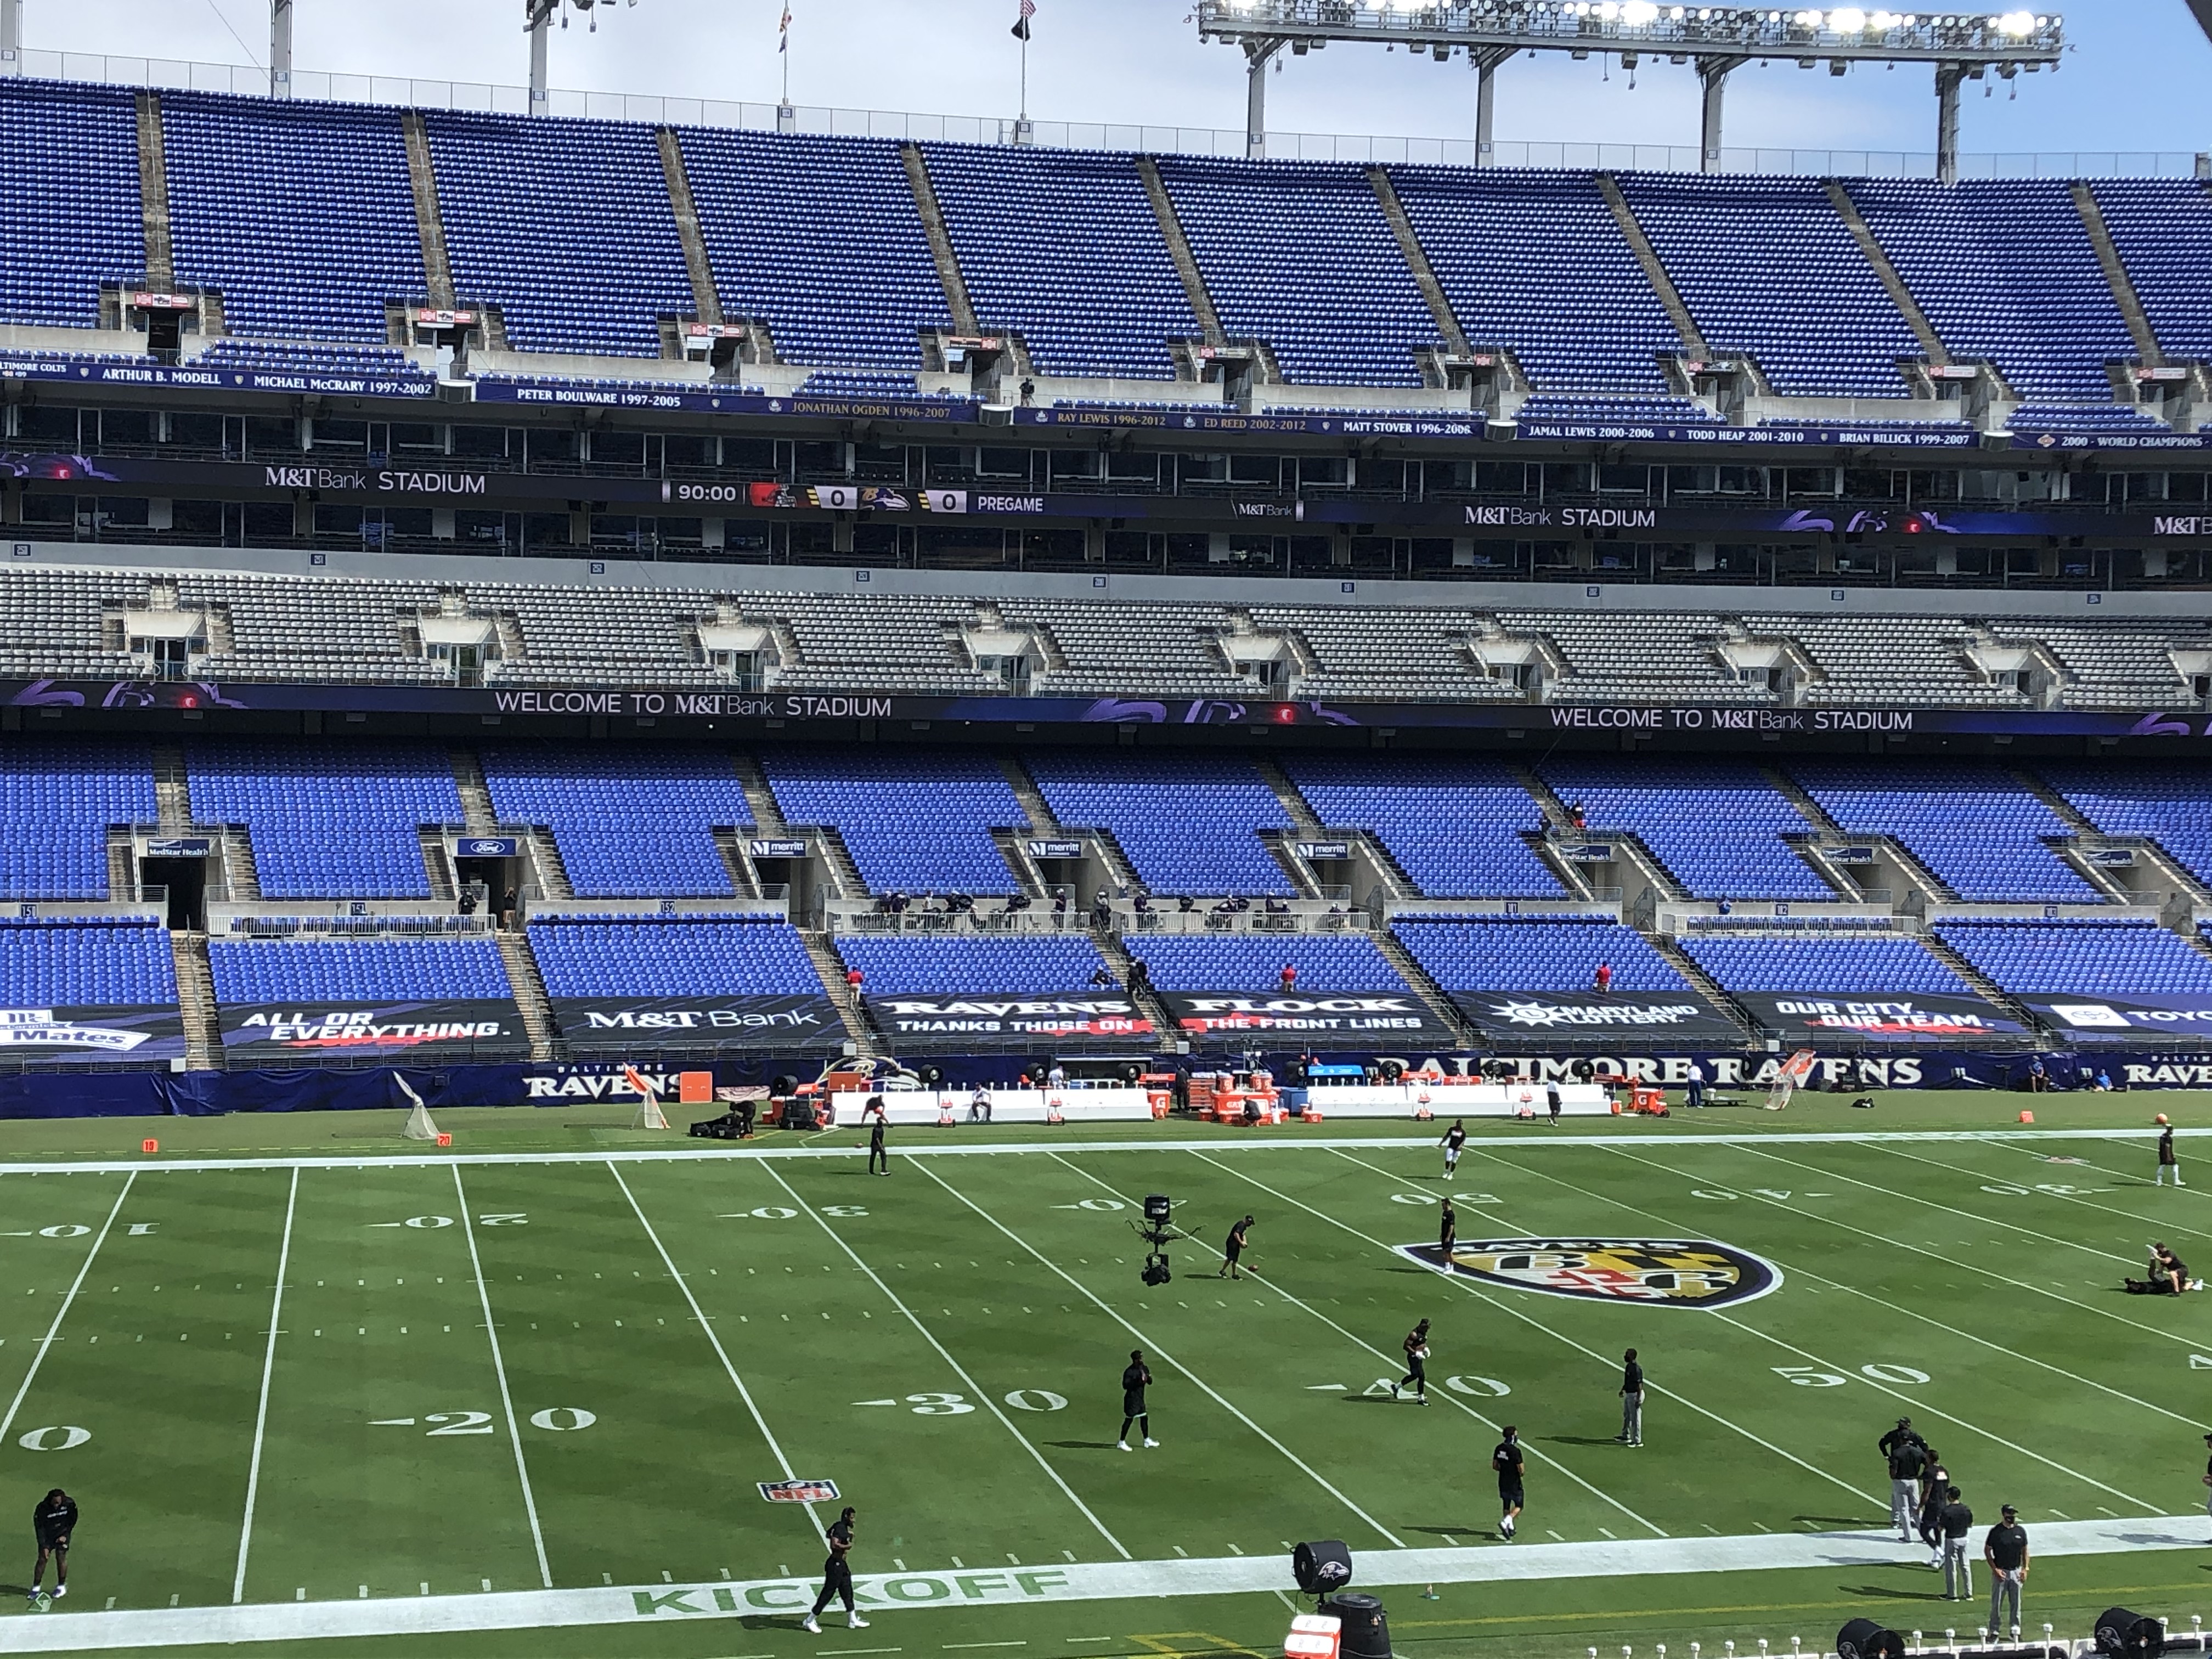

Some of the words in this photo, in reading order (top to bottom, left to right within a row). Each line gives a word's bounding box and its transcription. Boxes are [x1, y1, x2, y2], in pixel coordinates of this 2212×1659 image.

[40, 364, 66, 373] COLTS
[103, 369, 154, 381] ARTHUR
[156, 370, 167, 381] B.
[172, 371, 221, 384] MODELL
[254, 375, 307, 389] MICHAEL
[310, 379, 365, 391] McCRARY
[370, 381, 432, 396] 1997-2002
[517, 388, 552, 400] PETER
[556, 391, 617, 404] BOULWARE
[620, 394, 681, 407] 1997-2005
[792, 402, 849, 415] JONATHAN
[852, 404, 890, 416] OGDEN
[893, 406, 950, 418] 1996-2007
[1058, 413, 1077, 423] RAY
[1079, 413, 1110, 424] LEWIS
[1113, 415, 1166, 426] 1996-2012
[1204, 418, 1218, 428] ED
[1221, 419, 1247, 429] REED
[1250, 420, 1306, 430] 2002-2012
[1344, 421, 1372, 433] MATT
[1373, 422, 1413, 434] STOVER
[1528, 426, 1562, 437] JAMAL
[1565, 426, 1596, 437] LEWIS
[1598, 427, 1655, 438] 2000-2006
[1686, 429, 1716, 439] TODD
[1718, 430, 1745, 441] HEAP
[1747, 431, 1804, 442] 2001-2010
[1839, 433, 1871, 443] BRIAN
[1873, 433, 1912, 444] BILLICK
[1915, 434, 1970, 444] 1999-2007
[2061, 436, 2088, 447] 2000
[2097, 437, 2137, 447] WORLD
[2140, 437, 2203, 447] CHAMPIONS
[265, 466, 317, 488] M&T
[319, 468, 366, 490] Bank
[377, 471, 486, 494] STADIUM
[679, 485, 736, 501] 90:00
[831, 490, 845, 507] 0
[942, 494, 957, 511] 0
[978, 495, 1043, 512] PREGAME
[1238, 503, 1267, 516] M&T
[1266, 504, 1293, 516] Bank
[1464, 506, 1510, 524] M&T
[1510, 507, 1552, 526] Bank
[1561, 508, 1655, 528] STADIUM
[2153, 517, 2201, 534] M&T
[495, 691, 622, 713] WELCOME
[630, 694, 665, 714] TO
[674, 694, 726, 715] M&T
[727, 695, 775, 715] Bank
[786, 696, 891, 717] STADIUM
[1550, 708, 1663, 727] WELCOME
[1670, 709, 1703, 728] TO
[1711, 709, 1758, 729] M&T
[1759, 710, 1804, 730] Bank
[1814, 711, 1912, 730] STADIUM
[476, 842, 499, 852] Ford
[771, 842, 804, 850] merritt
[1048, 843, 1079, 852] merritt
[1316, 844, 1346, 853] merritt
[21, 906, 36, 917] 150
[661, 902, 674, 913] 152
[878, 1001, 1132, 1017] RAVENS
[1182, 998, 1417, 1012] FLOCK
[1559, 1005, 1700, 1015] MARYLAND
[1775, 1002, 1836, 1014] OUR
[1846, 1002, 1925, 1015] CITY.
[241, 1013, 311, 1026] ALL
[325, 1013, 374, 1025] OR
[584, 1012, 703, 1029] M&T
[708, 1010, 821, 1028] Bank
[896, 1020, 1001, 1032] THANKS
[1010, 1020, 1091, 1032] THOSE
[1099, 1020, 1133, 1031] ON
[1201, 1018, 1252, 1029] THE
[1260, 1018, 1341, 1029] FRONT
[1350, 1018, 1422, 1029] LINES
[1819, 1014, 1884, 1027] OUR
[1889, 1014, 1995, 1027] TEAM.
[13, 1030, 126, 1043] Mates
[270, 1022, 511, 1040] EVERYTHING.
[558, 1064, 663, 1074] BALTIMORE
[1156, 1097, 1166, 1108] G
[1638, 1095, 1647, 1105] G
[145, 1141, 154, 1150] 10
[772, 1488, 832, 1499] NFL
[631, 1571, 1069, 1616] KICKOFF
